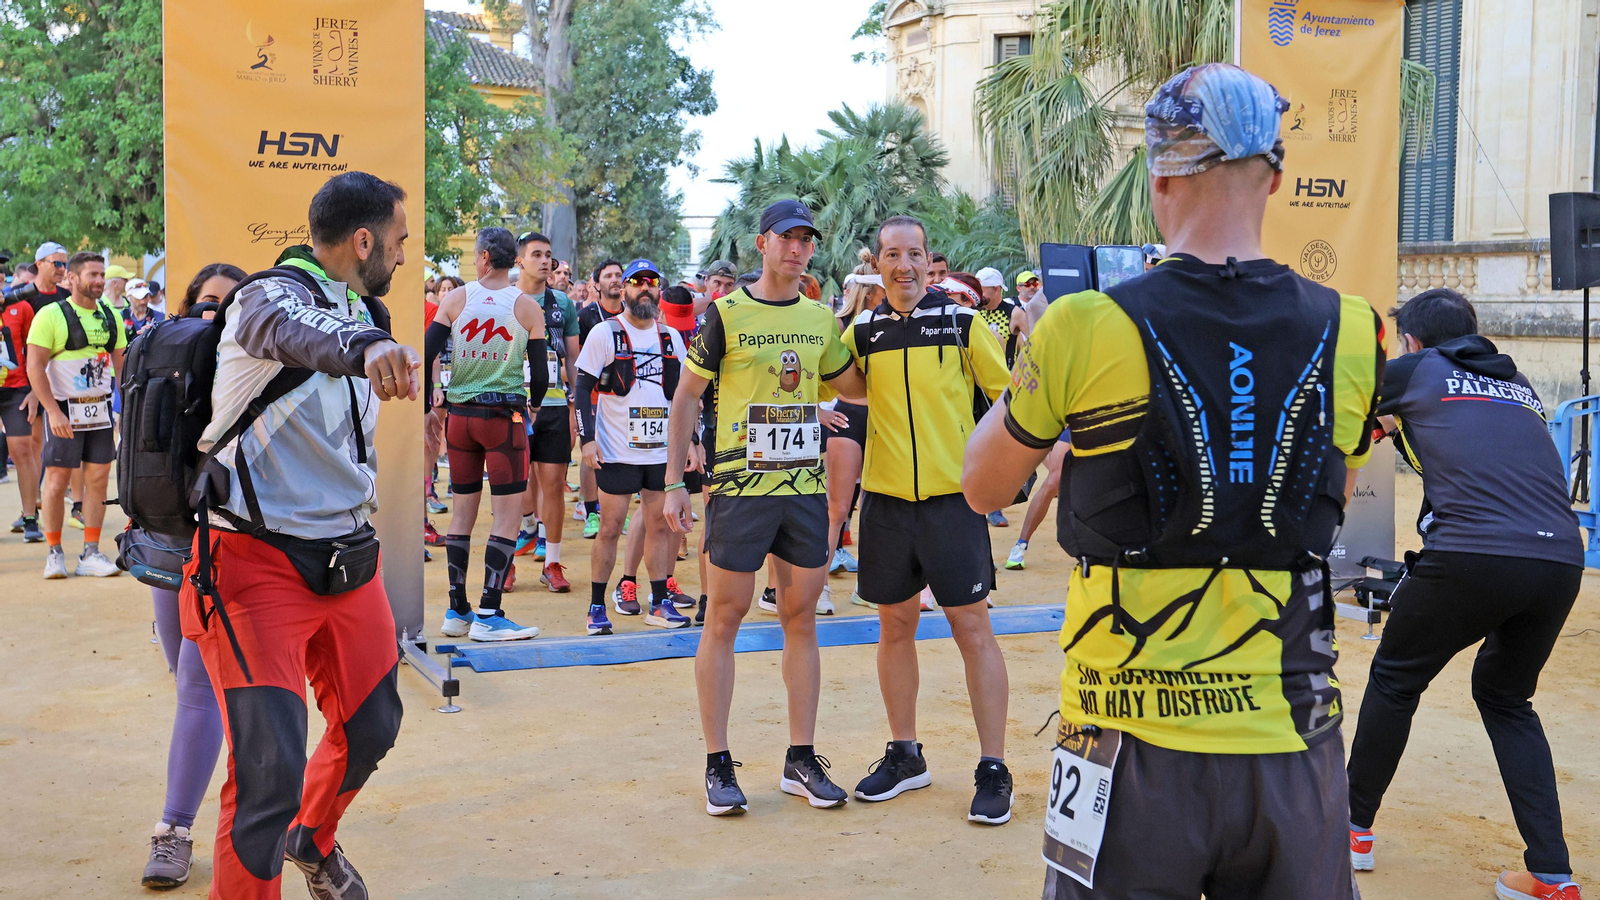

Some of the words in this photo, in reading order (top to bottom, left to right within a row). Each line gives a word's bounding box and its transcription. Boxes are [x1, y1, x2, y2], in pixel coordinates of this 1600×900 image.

[313, 17, 358, 31] JEREZ
[1302, 11, 1375, 26] Ayuntamiento
[1300, 24, 1312, 34] de
[1314, 25, 1341, 37] Jerez
[313, 40, 323, 68] VINOS
[348, 38, 358, 76] WINES
[313, 75, 358, 87] SHERRY
[1329, 88, 1357, 99] JEREZ
[257, 130, 340, 158] HSN
[1328, 133, 1357, 143] SHERRY
[248, 160, 265, 168] WE
[268, 161, 289, 169] ARE
[292, 162, 348, 172] NUTRITION!
[1295, 177, 1346, 198] HSN
[247, 222, 312, 247] González
[1302, 242, 1335, 264] VALDESPINO
[1307, 270, 1330, 281] JEREZ
[738, 333, 824, 348] Paparunners
[461, 349, 509, 361] JEREZ
[1478, 375, 1533, 397] ATLETISMO
[84, 405, 98, 418] 82
[770, 407, 801, 421] Sherry
[1229, 341, 1255, 483] AONIJIE
[641, 421, 663, 436] 154
[767, 427, 805, 450] 174
[1078, 688, 1099, 715] NO
[1105, 688, 1146, 718] HAY
[1156, 685, 1262, 718] DISFRUTE
[1049, 757, 1082, 821] 92
